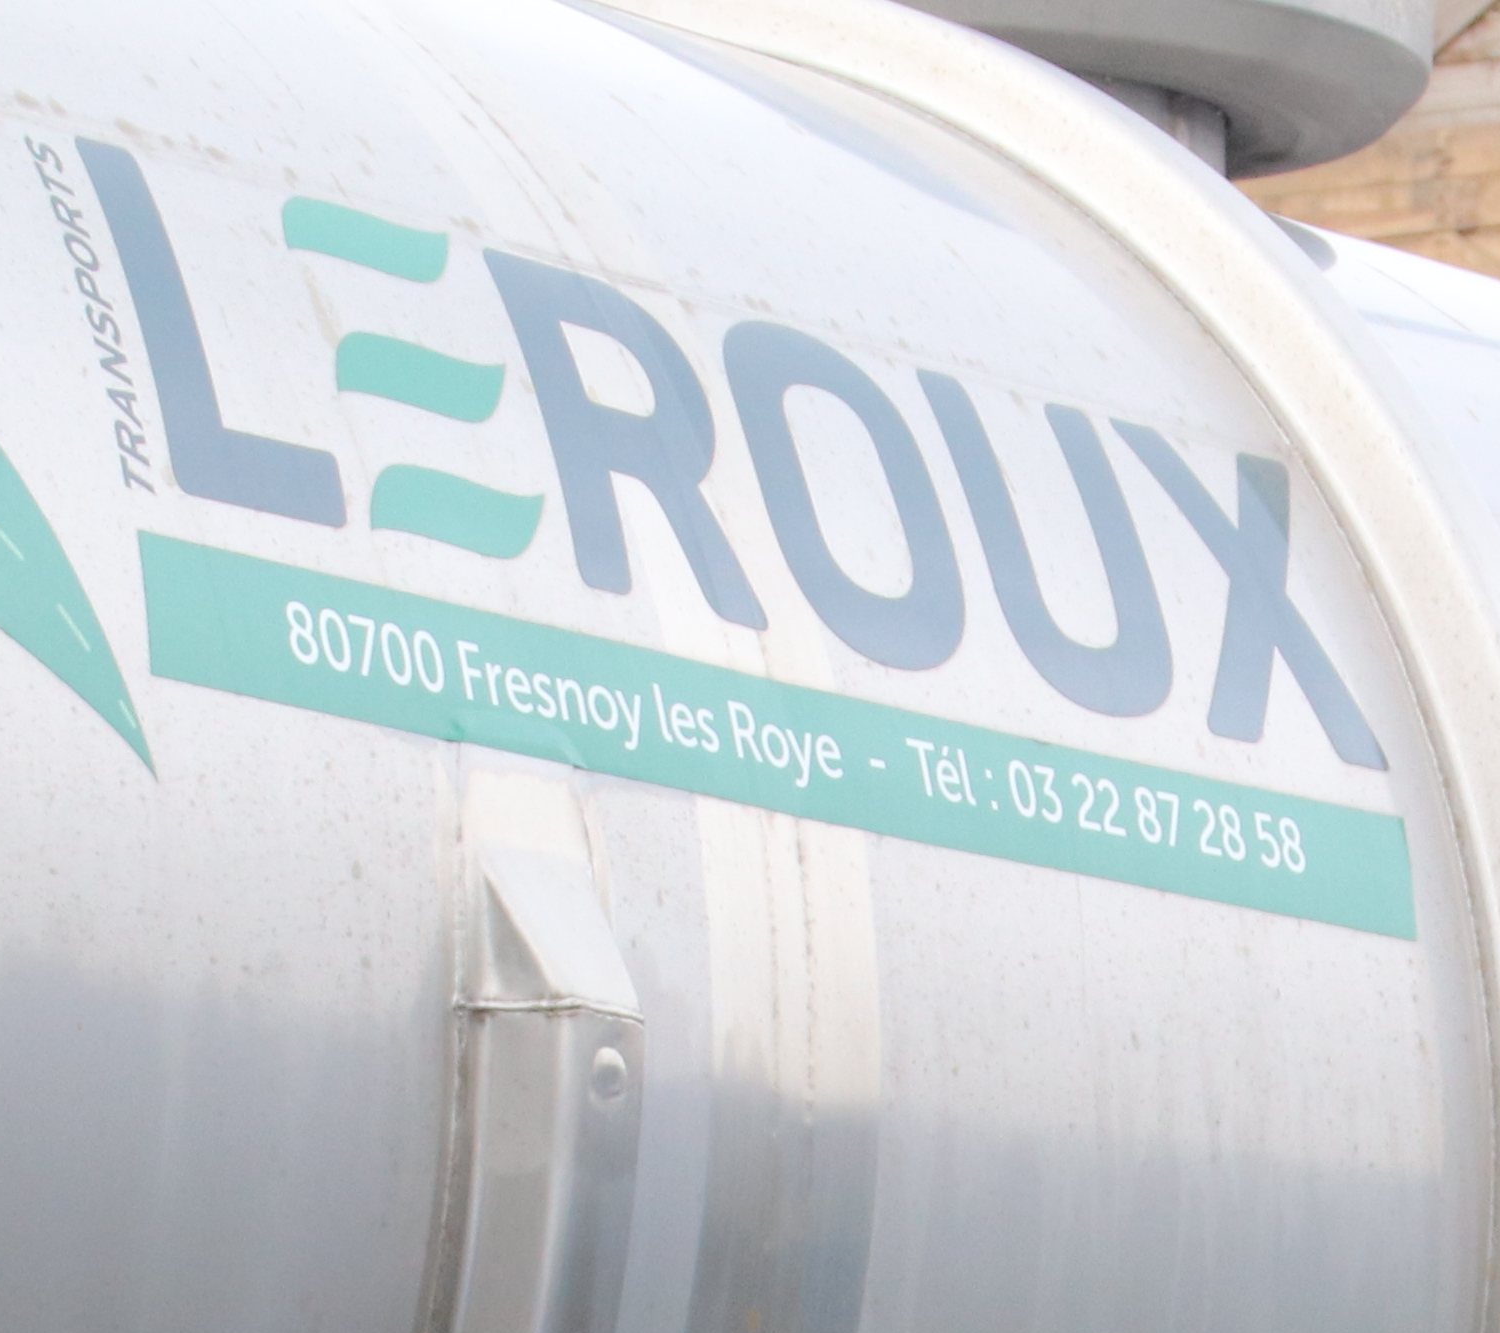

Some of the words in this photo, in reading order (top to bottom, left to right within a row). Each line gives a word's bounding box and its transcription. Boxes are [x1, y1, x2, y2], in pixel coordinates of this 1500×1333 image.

[24, 135, 158, 496] TRANSPORTS
[73, 135, 1389, 772] LEROUX
[285, 600, 446, 694] 80700
[456, 639, 642, 751] Fresnoy
[652, 682, 721, 753] les
[727, 699, 845, 788] Roye
[905, 736, 977, 807] Tél
[1007, 759, 1063, 824] 03
[1071, 773, 1127, 837] 22
[1134, 786, 1180, 847] 87
[1192, 797, 1247, 862] 28
[1253, 810, 1306, 874] 58
